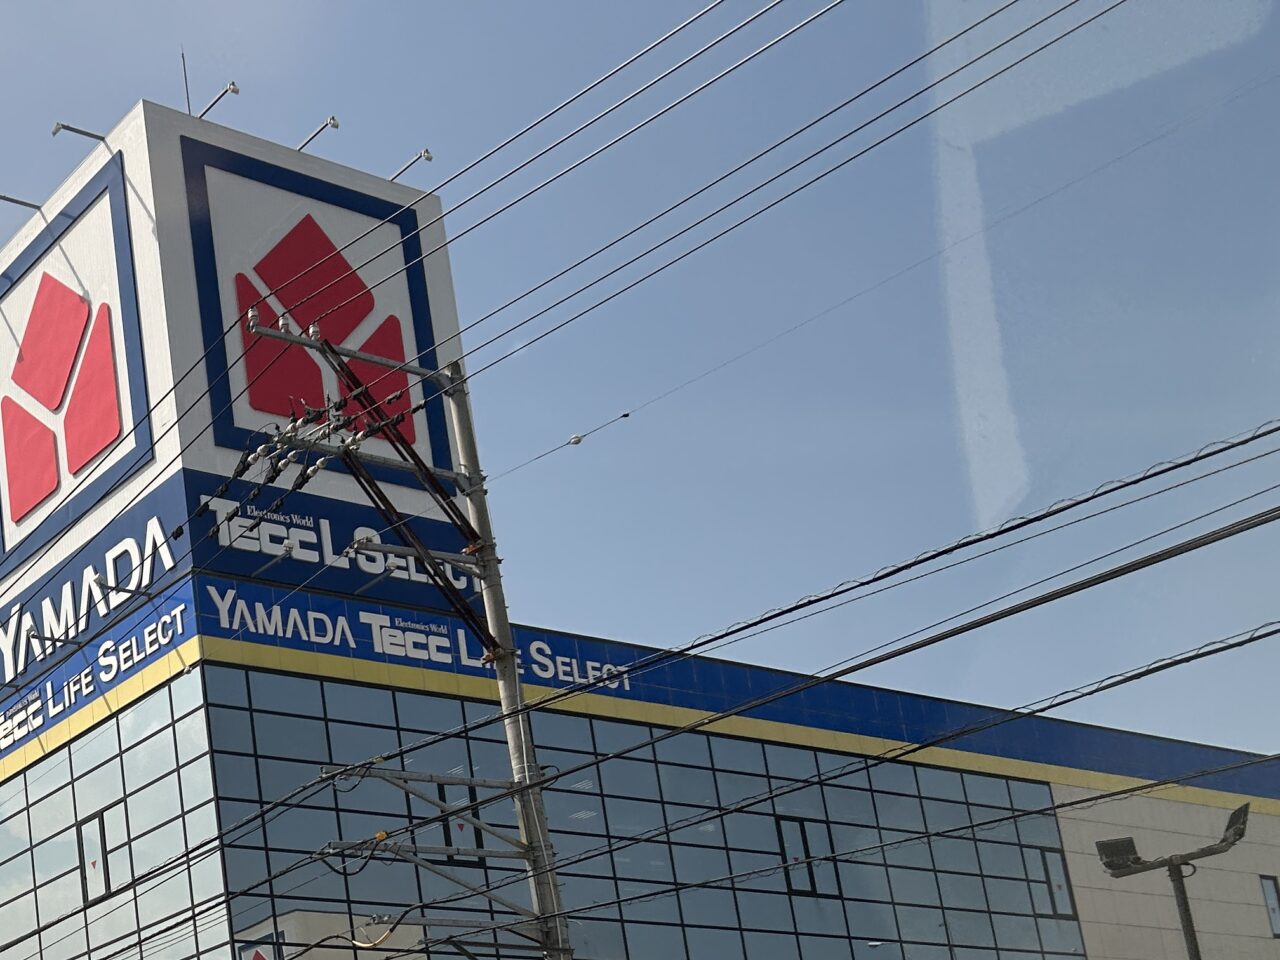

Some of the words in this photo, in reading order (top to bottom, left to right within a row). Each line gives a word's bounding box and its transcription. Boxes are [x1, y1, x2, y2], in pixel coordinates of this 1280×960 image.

[291, 513, 314, 528] World
[206, 585, 357, 648] YAMADA
[359, 611, 453, 664] Tecc
[529, 640, 631, 691] SELECT
[430, 622, 448, 635] World
[45, 665, 94, 718] LIFE
[98, 603, 186, 684] SELECT
